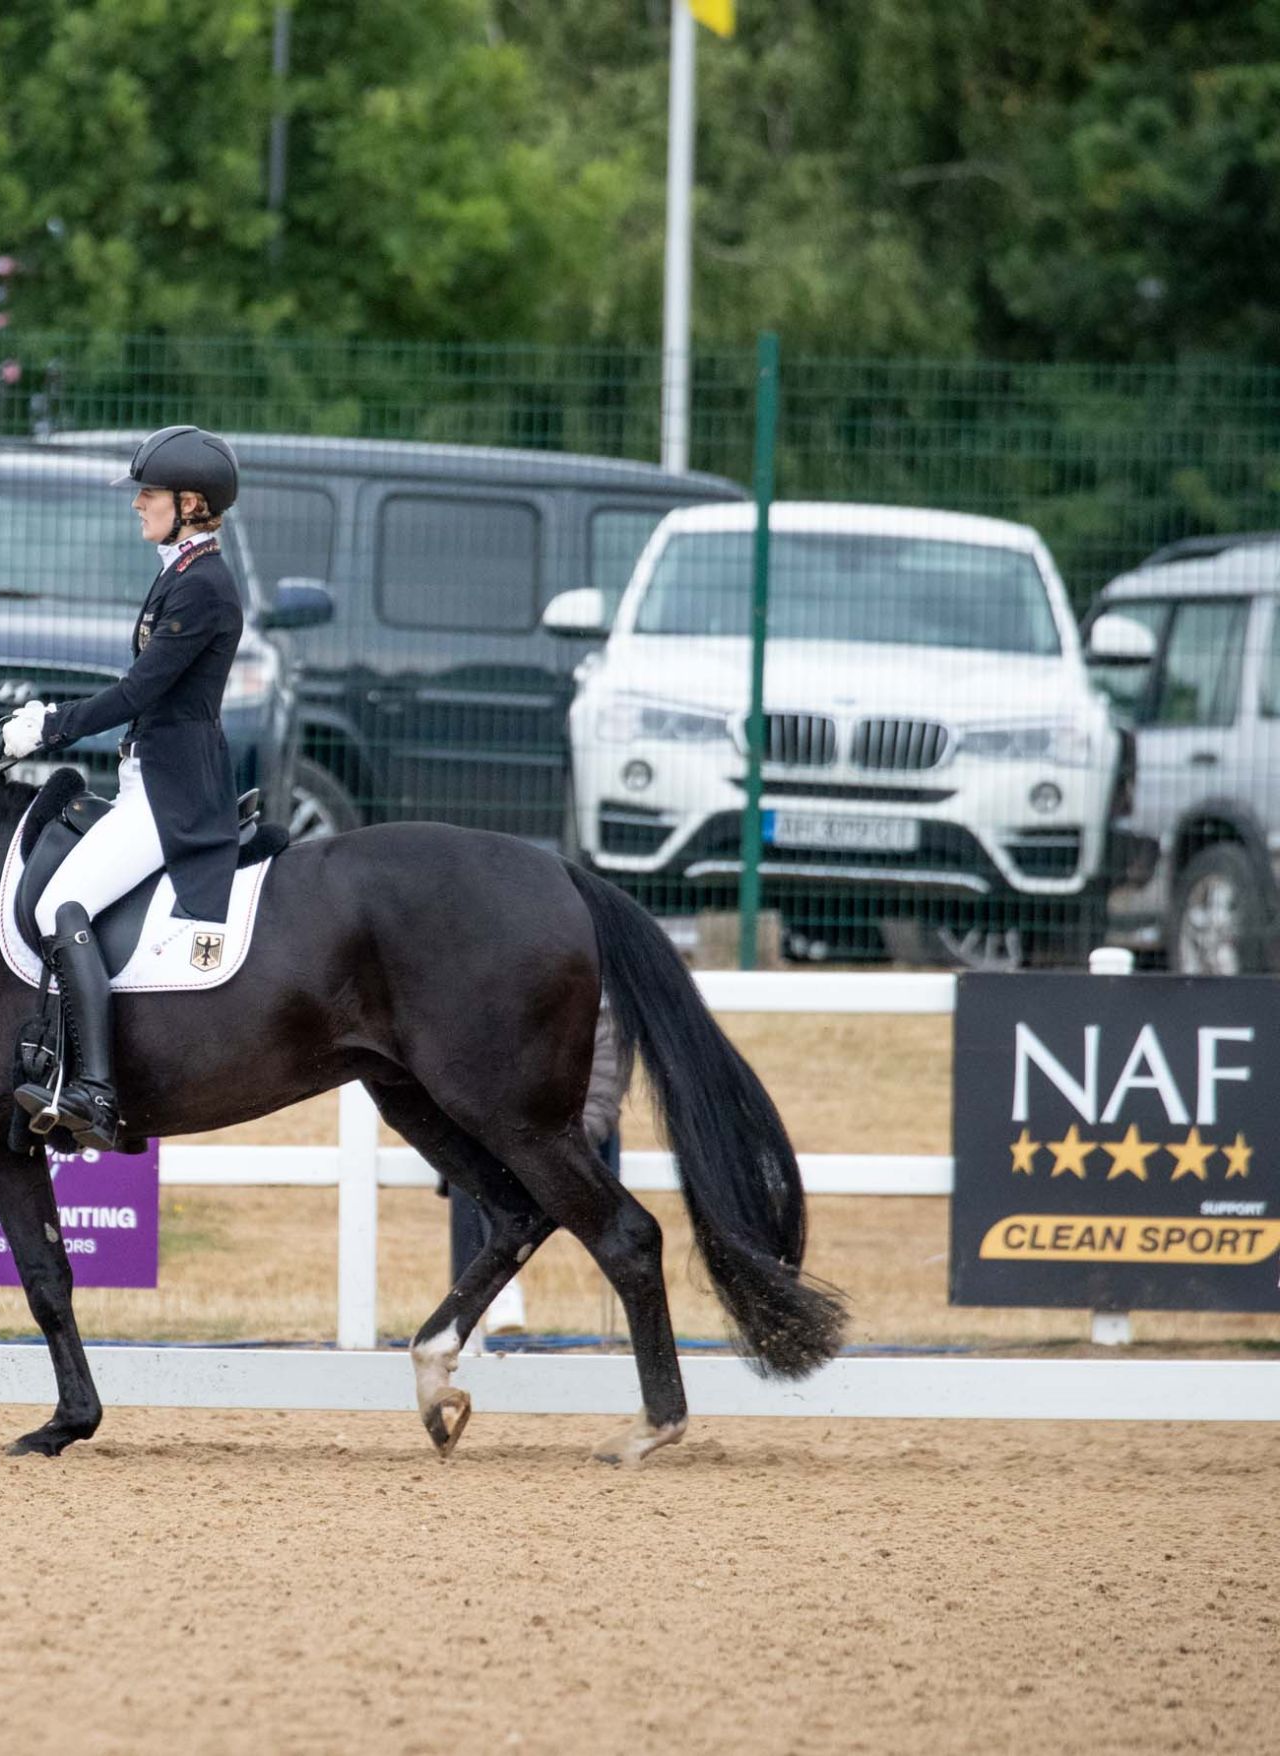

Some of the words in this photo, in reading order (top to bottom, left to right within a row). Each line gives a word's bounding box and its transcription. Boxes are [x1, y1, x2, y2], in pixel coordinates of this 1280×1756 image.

[1012, 1021, 1254, 1125] NAF
[1002, 1223, 1127, 1252] CLEAN
[1137, 1226, 1265, 1255] SPORT
